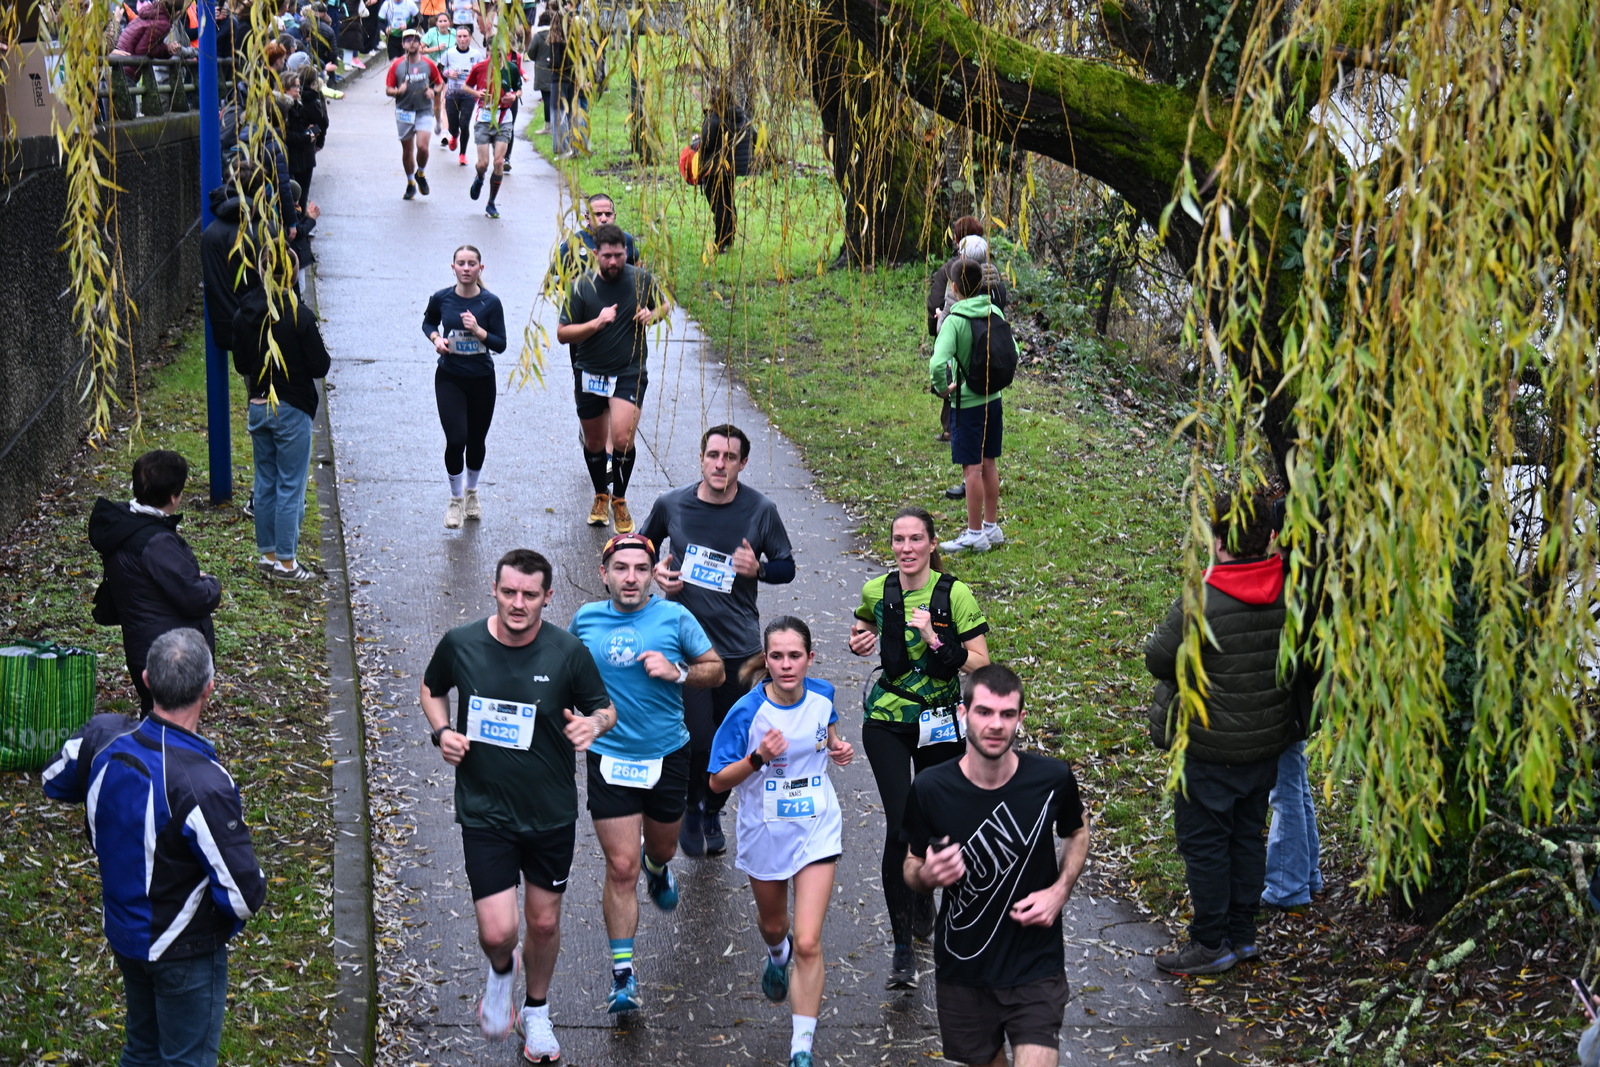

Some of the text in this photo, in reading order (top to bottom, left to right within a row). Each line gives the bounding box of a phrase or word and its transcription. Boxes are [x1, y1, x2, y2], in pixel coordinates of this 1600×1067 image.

[34, 80, 46, 108] staci
[693, 567, 724, 584] 1720
[610, 636, 622, 646] 42
[482, 723, 519, 740] 1020
[612, 764, 649, 780] 2604
[782, 800, 810, 814] 712
